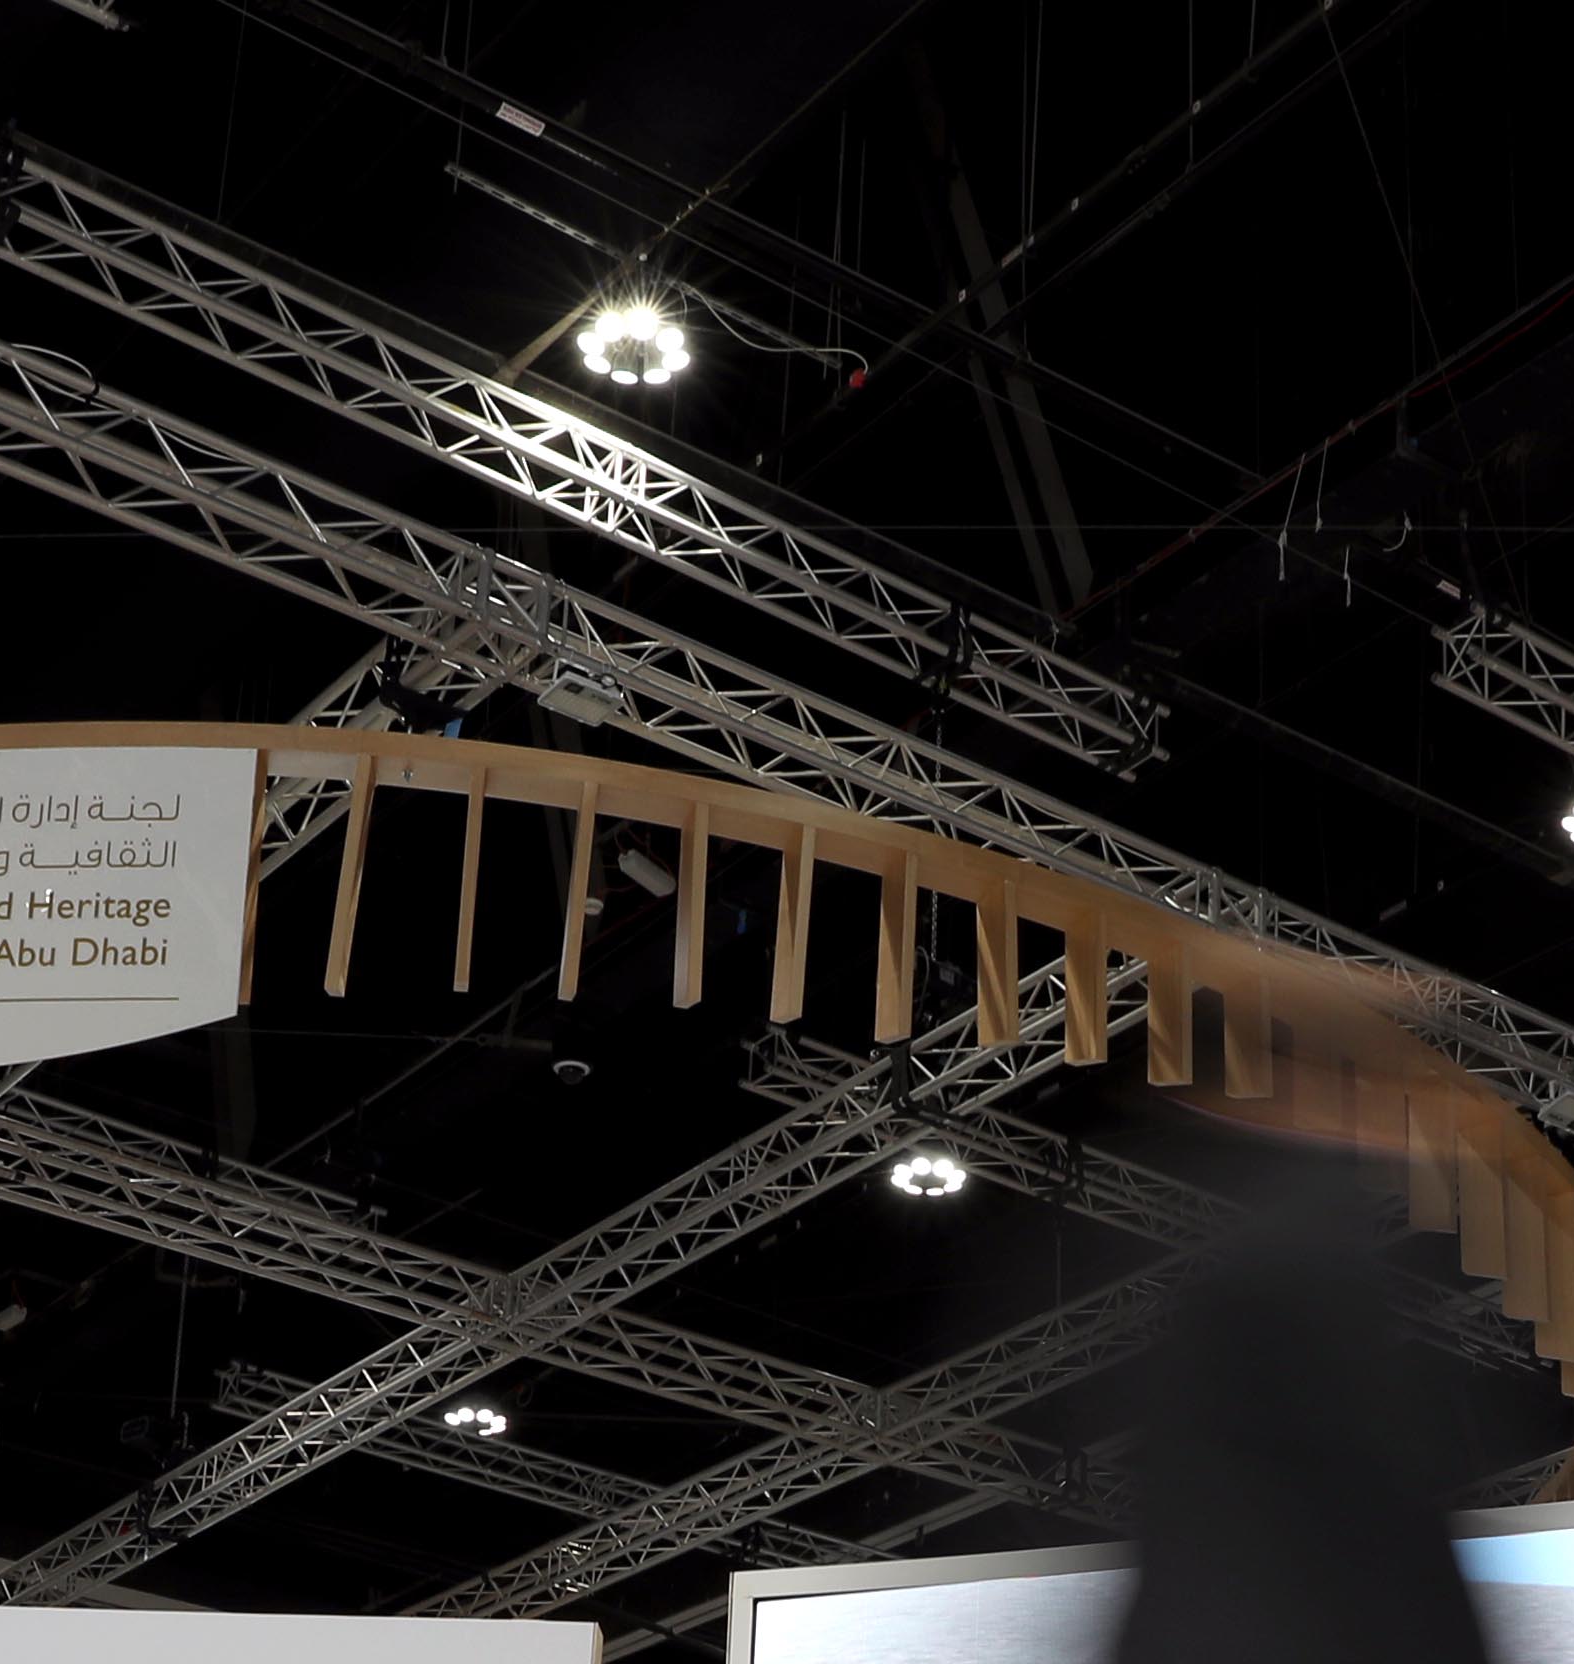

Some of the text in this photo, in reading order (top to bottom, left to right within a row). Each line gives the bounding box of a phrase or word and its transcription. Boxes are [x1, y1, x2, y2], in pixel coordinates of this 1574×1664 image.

[12, 794, 79, 829] إدارة
[87, 794, 181, 828] لجنة
[19, 837, 177, 876] الثقافية
[28, 891, 171, 927] Heritage
[71, 937, 168, 966] Dhabi
